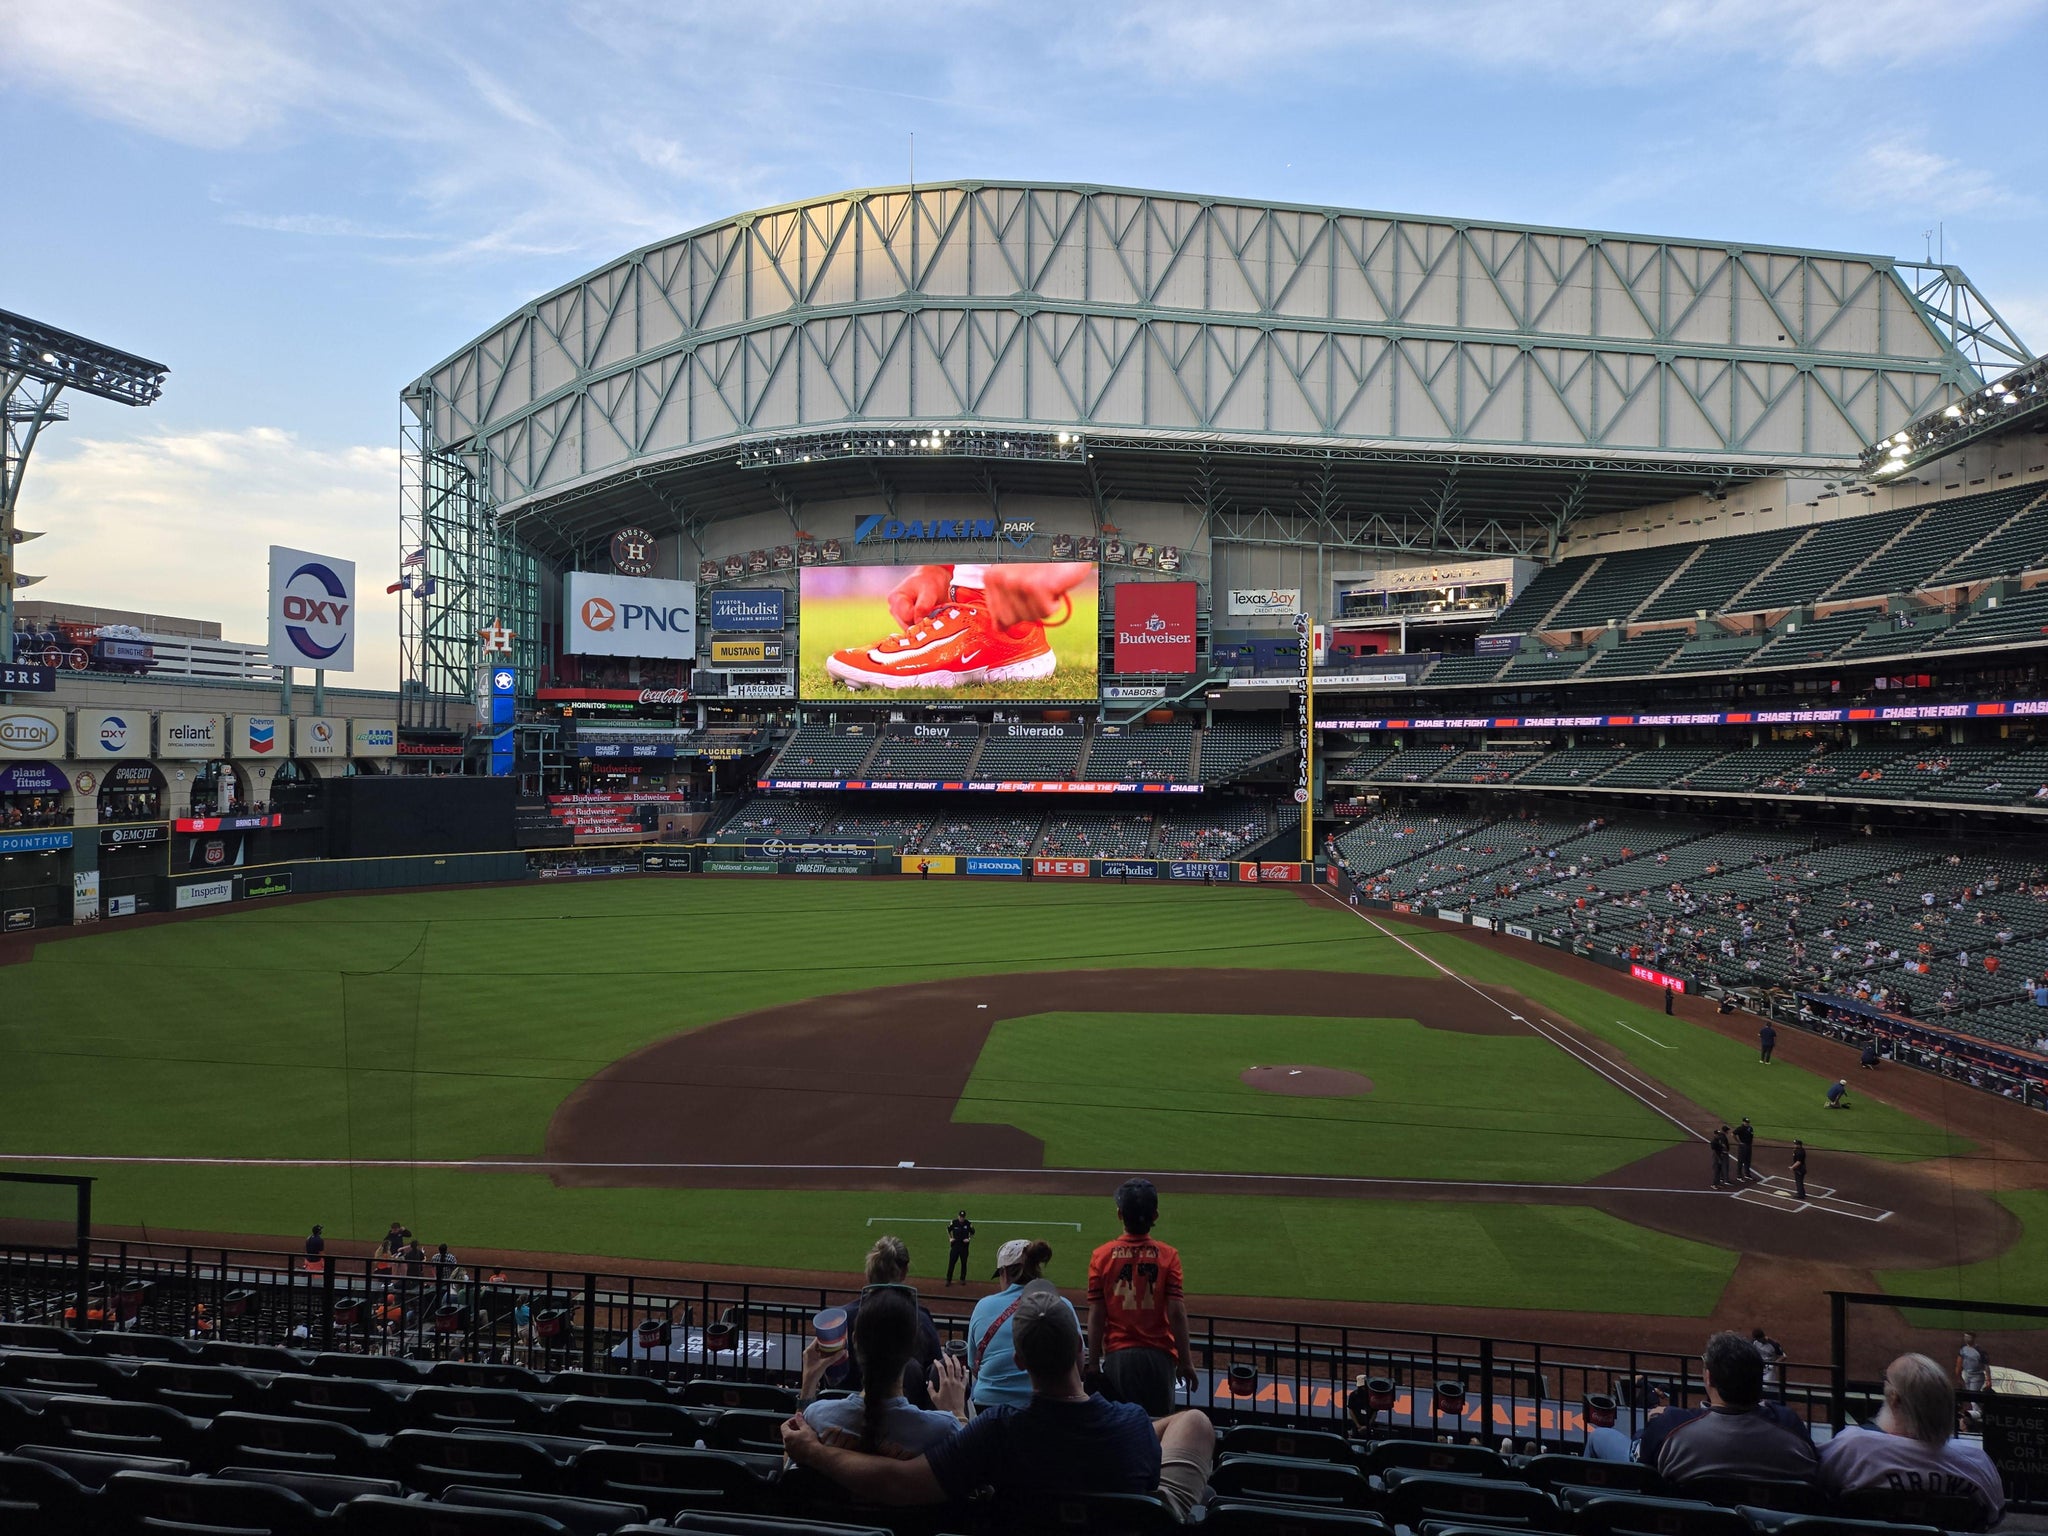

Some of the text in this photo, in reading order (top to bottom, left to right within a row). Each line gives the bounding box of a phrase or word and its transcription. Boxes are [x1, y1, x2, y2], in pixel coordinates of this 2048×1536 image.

[882, 519, 1035, 540] DAIKIN PARK
[617, 529, 654, 546] HOUSTON
[628, 543, 645, 560] H
[1111, 539, 1119, 553] 5
[1137, 543, 1147, 556] 7
[1161, 546, 1177, 559] 13
[618, 560, 652, 574] ASTROS
[1233, 592, 1295, 607] Texas Bay
[283, 596, 349, 626] OXY
[717, 602, 778, 616] Methodist
[620, 603, 690, 633] PNC
[721, 646, 780, 656] MUSTANG CAT
[1299, 639, 1308, 677] ROOT
[738, 686, 786, 696] HARGROVE
[1757, 710, 1842, 722] CHASE THE FIGHT
[1882, 705, 1969, 718] CHASE THE FIGHT
[249, 717, 275, 726] Chevron
[1314, 721, 1338, 729] HASE
[1338, 721, 1356, 729] THE
[1414, 719, 1489, 728] CHASE THE FIGHT
[1524, 717, 1602, 727] CHASE THE FIGHT
[1639, 713, 1720, 725] CHASE THE FIGHT
[101, 730, 126, 738] OXY
[169, 725, 211, 740] reliant
[368, 729, 393, 746] LNG
[914, 725, 1064, 738] Chevy Silverado
[397, 742, 464, 754] Budweiser
[12, 767, 46, 780] planet
[593, 763, 643, 773] Budweiser
[16, 777, 52, 788] fitness
[123, 829, 158, 841] EMCJET
[208, 849, 220, 860] 66
[795, 864, 814, 873] SPACE
[813, 864, 826, 873] CITY
[76, 887, 97, 897] WM
[191, 884, 229, 898] Insperity
[1114, 1263, 1159, 1311] 47
[1985, 1413, 2045, 1431] PLEASE
[2014, 1446, 2036, 1458] OR
